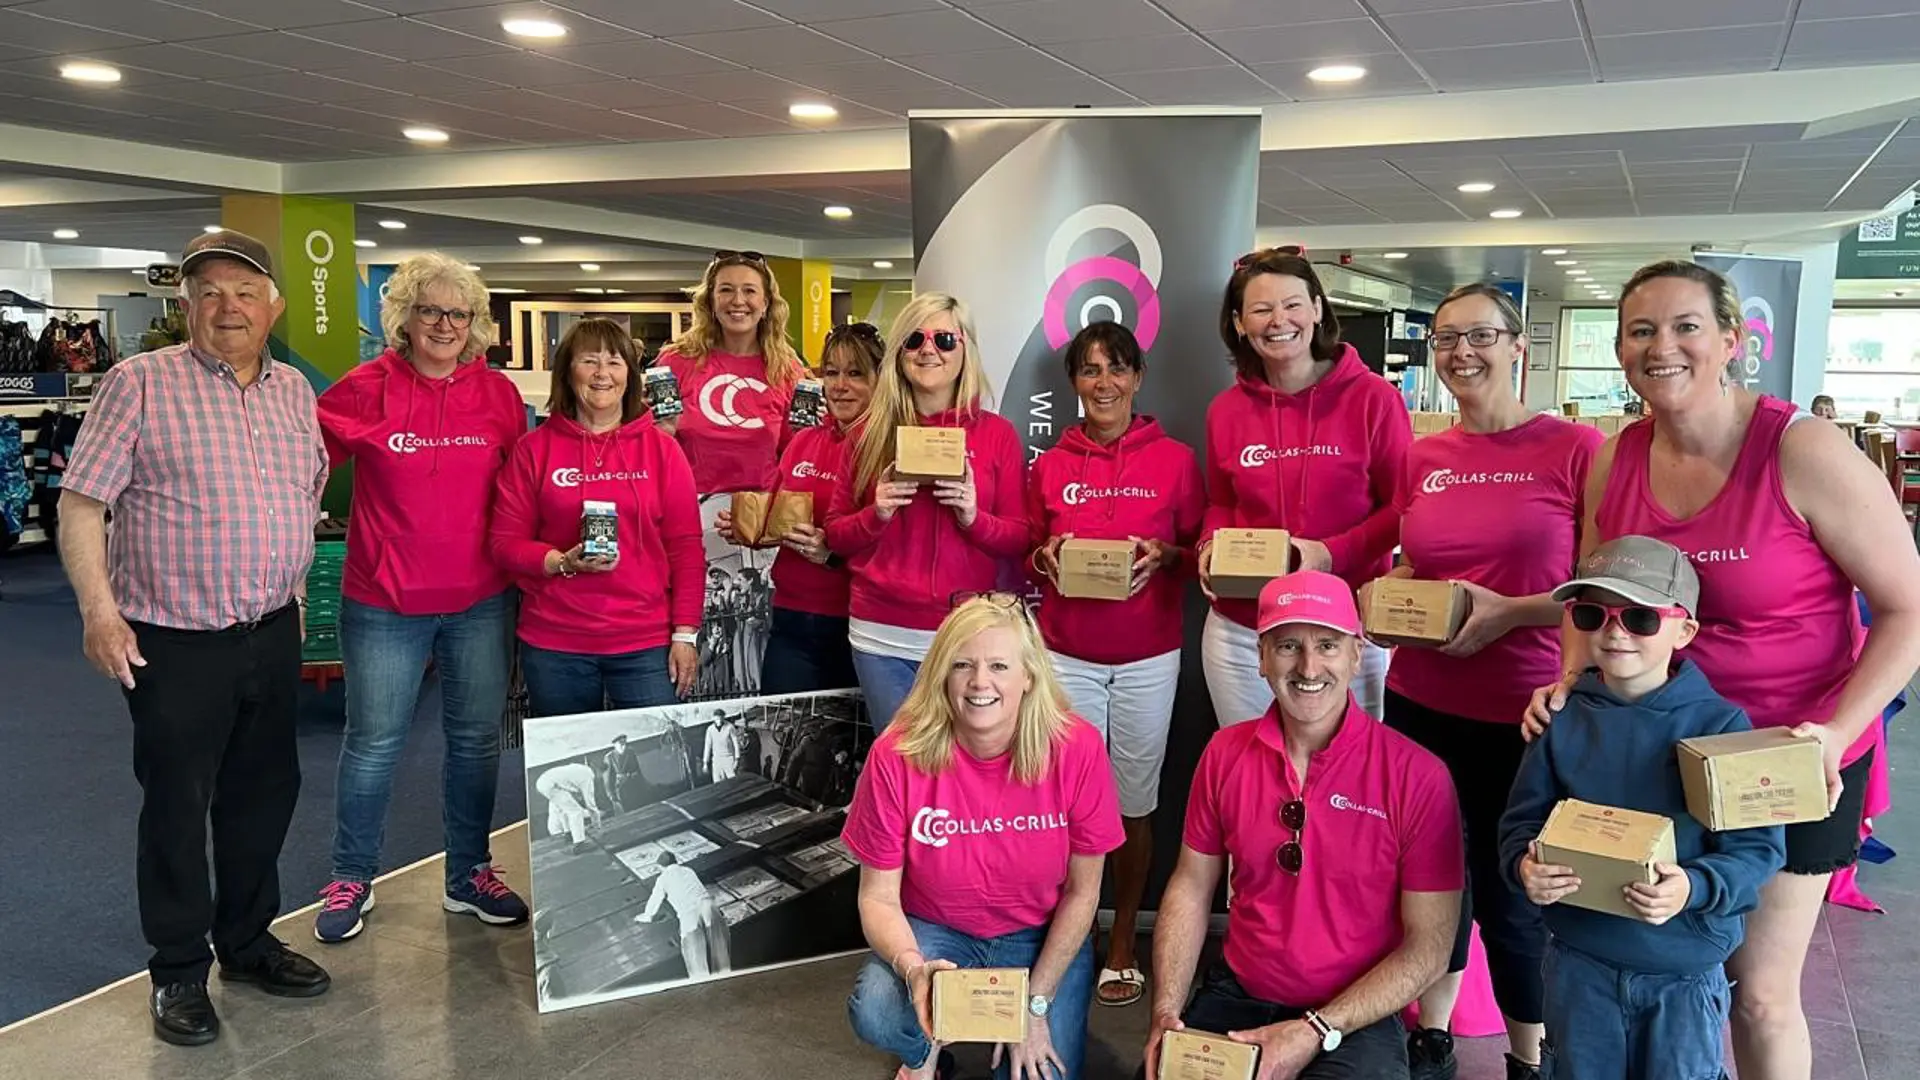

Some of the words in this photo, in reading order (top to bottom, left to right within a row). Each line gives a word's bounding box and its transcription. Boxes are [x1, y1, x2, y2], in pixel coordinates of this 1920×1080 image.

[312, 266, 329, 335] Sports
[1029, 391, 1053, 436] WE
[588, 526, 616, 537] MILK
